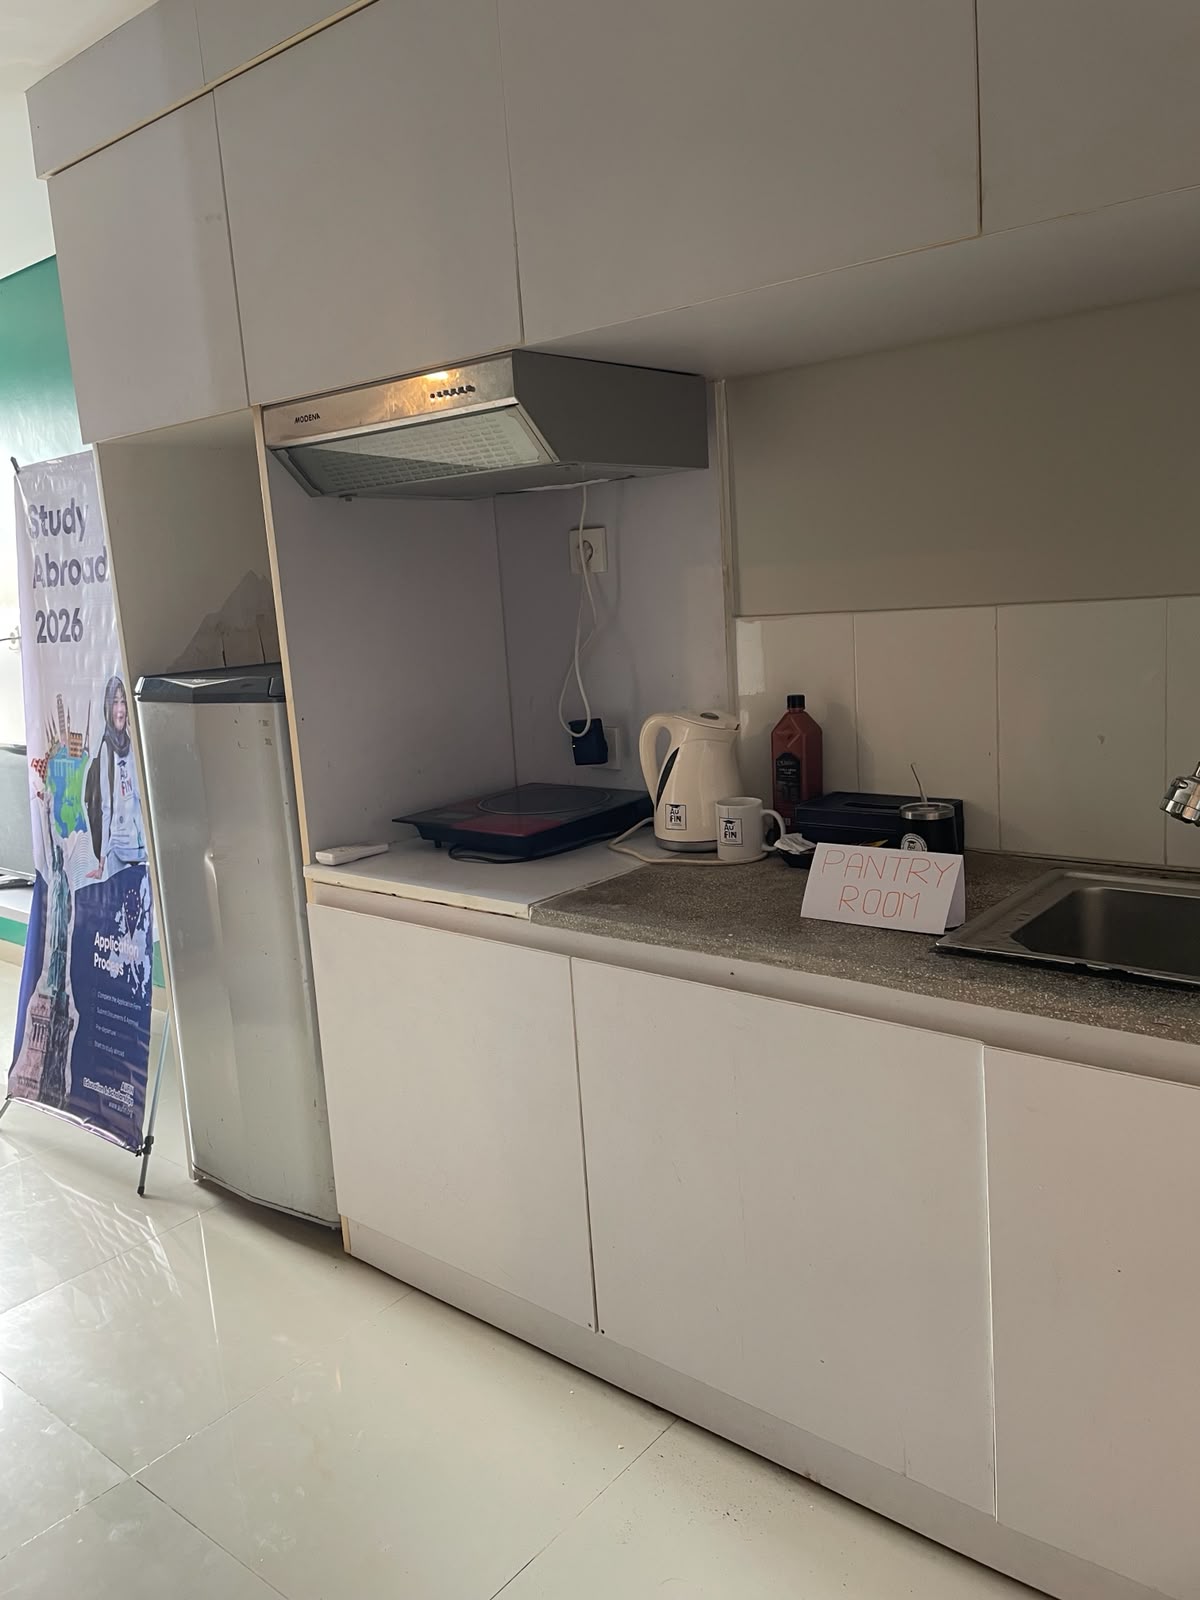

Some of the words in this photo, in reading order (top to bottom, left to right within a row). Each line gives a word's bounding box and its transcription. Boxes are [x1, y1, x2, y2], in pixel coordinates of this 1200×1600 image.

[294, 413, 321, 424] MODENA
[28, 498, 88, 542] Study
[33, 546, 108, 589] Abroad
[35, 608, 84, 643] 2026
[670, 815, 682, 823] FIN
[724, 831, 737, 839] FIN
[822, 849, 955, 888] PANTRY
[838, 885, 921, 920] ROOM
[94, 931, 139, 959] Application
[94, 952, 124, 976] Process
